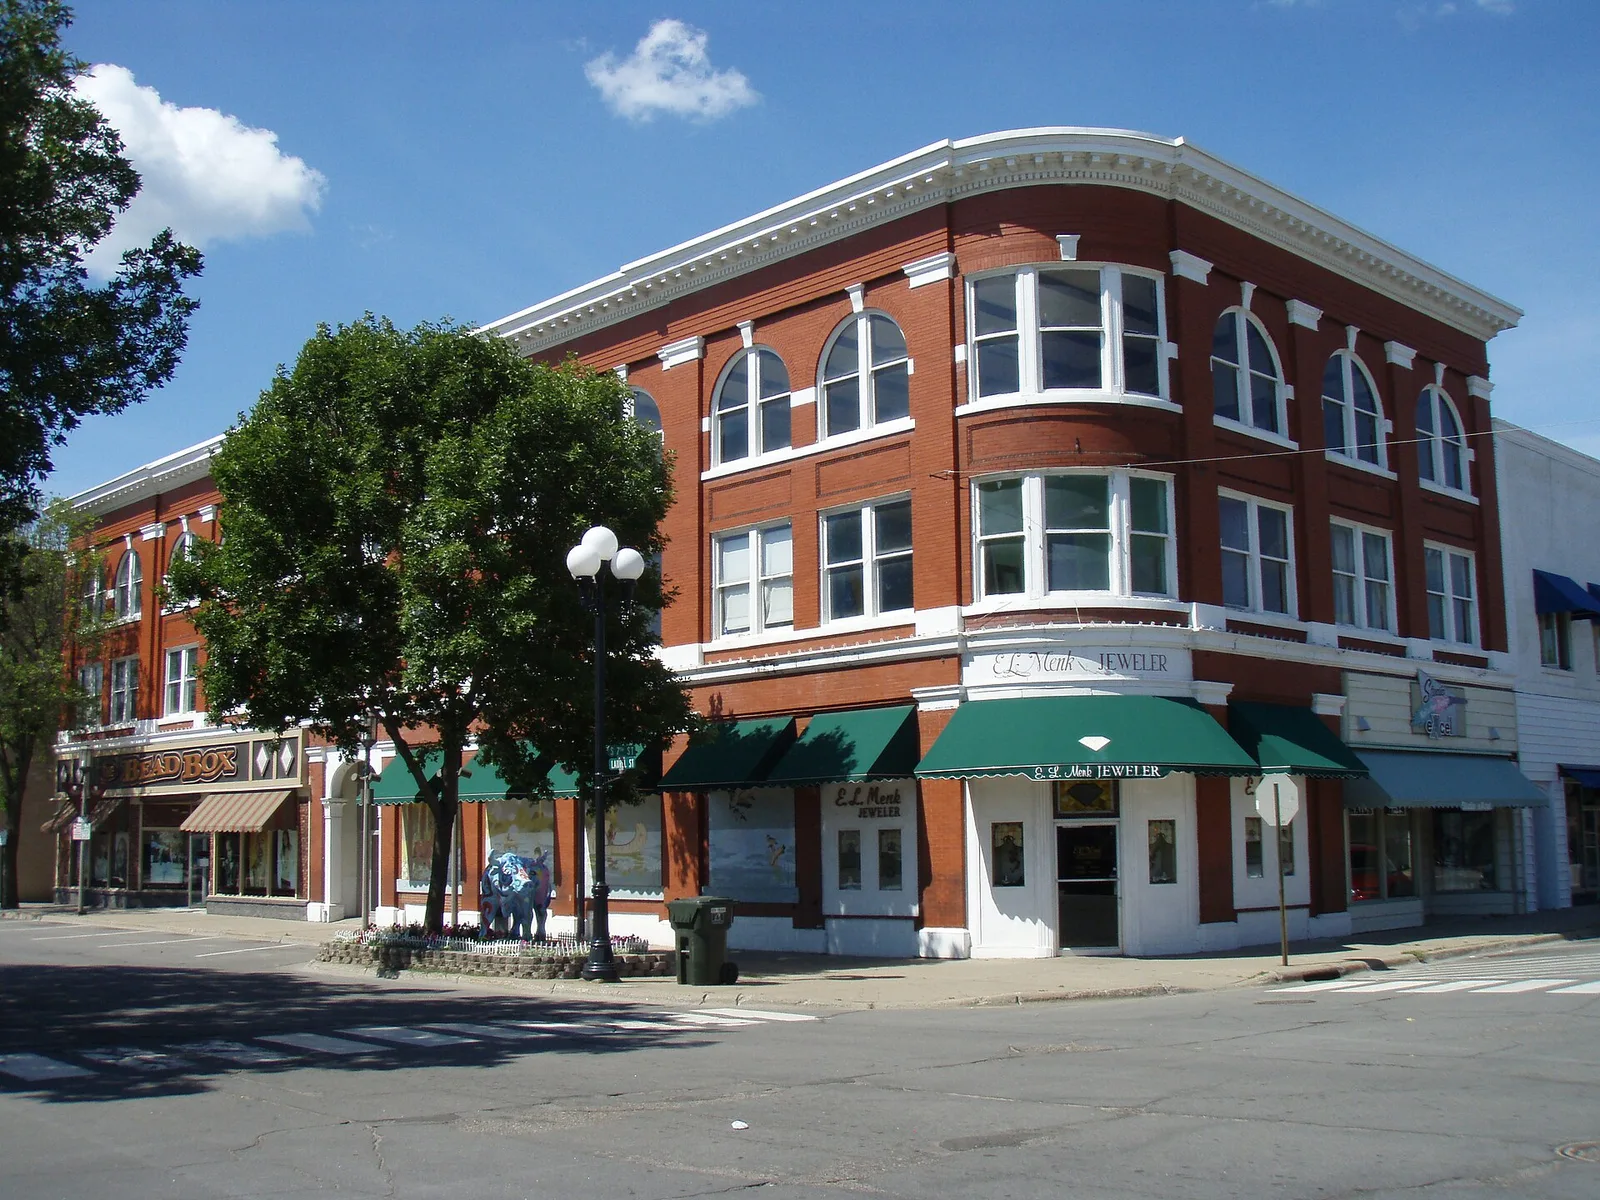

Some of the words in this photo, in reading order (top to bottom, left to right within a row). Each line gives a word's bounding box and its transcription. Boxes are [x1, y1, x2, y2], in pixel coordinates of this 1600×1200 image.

[1030, 650, 1075, 672] Menk
[1098, 653, 1168, 672] JEWELER
[627, 746, 635, 756] ST
[122, 754, 181, 783] BEAD
[183, 750, 236, 781] BOX
[628, 758, 635, 769] ST
[1064, 765, 1093, 778] Menk
[1095, 765, 1161, 779] JEWELER
[866, 786, 901, 805] Menk
[858, 806, 901, 818] JEWELER
